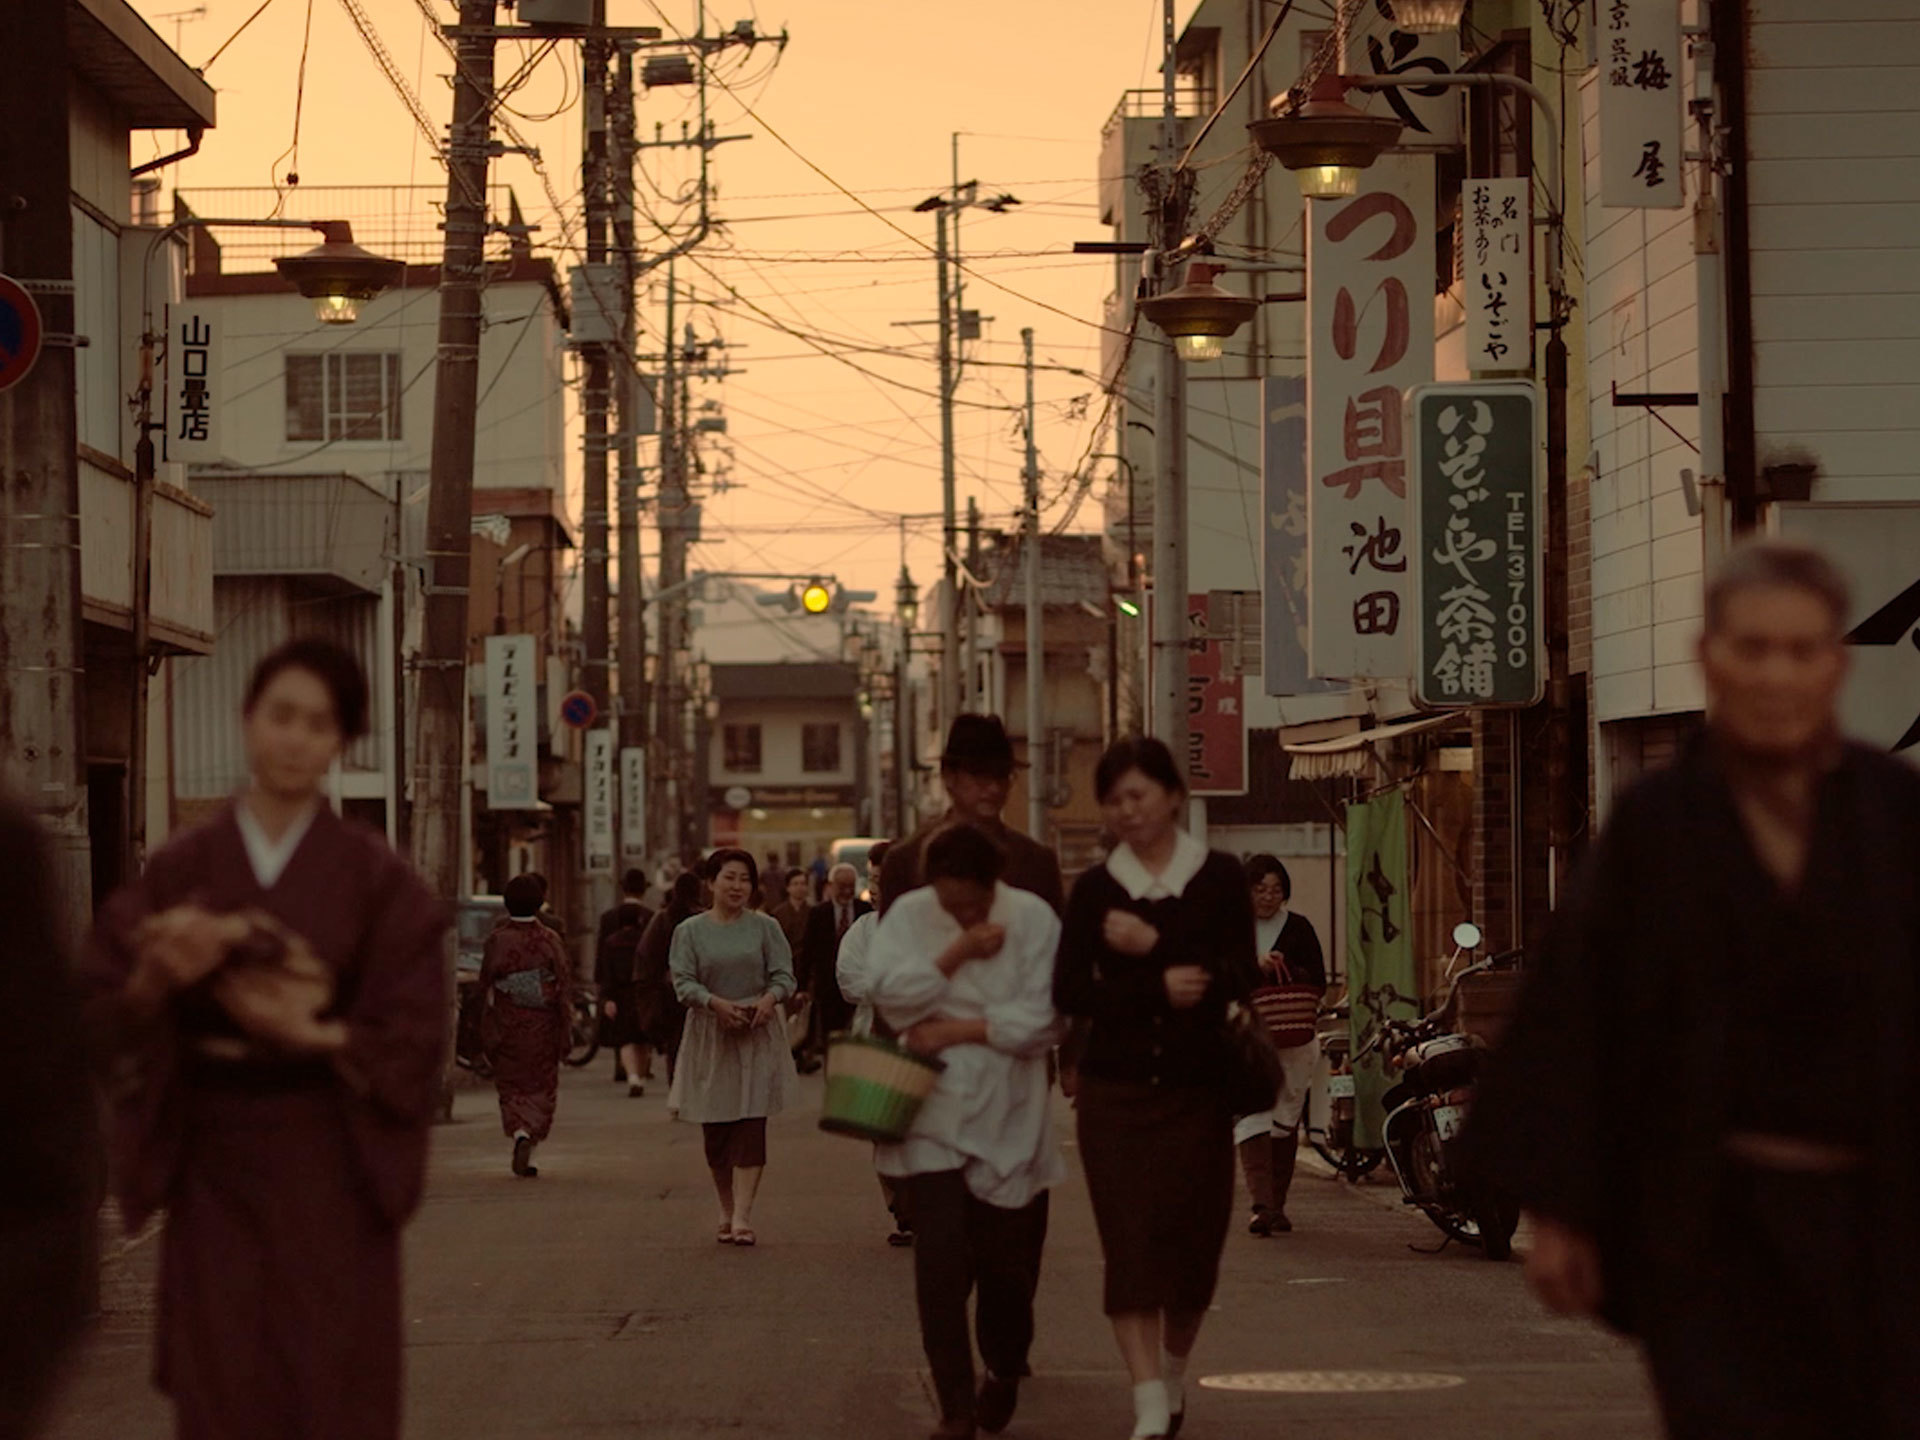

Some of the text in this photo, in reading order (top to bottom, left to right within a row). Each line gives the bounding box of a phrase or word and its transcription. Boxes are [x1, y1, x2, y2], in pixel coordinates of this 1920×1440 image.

[1632, 49, 1673, 188] 梅屋
[178, 315, 211, 441] 山口畳店
[1481, 271, 1510, 362] いそごや
